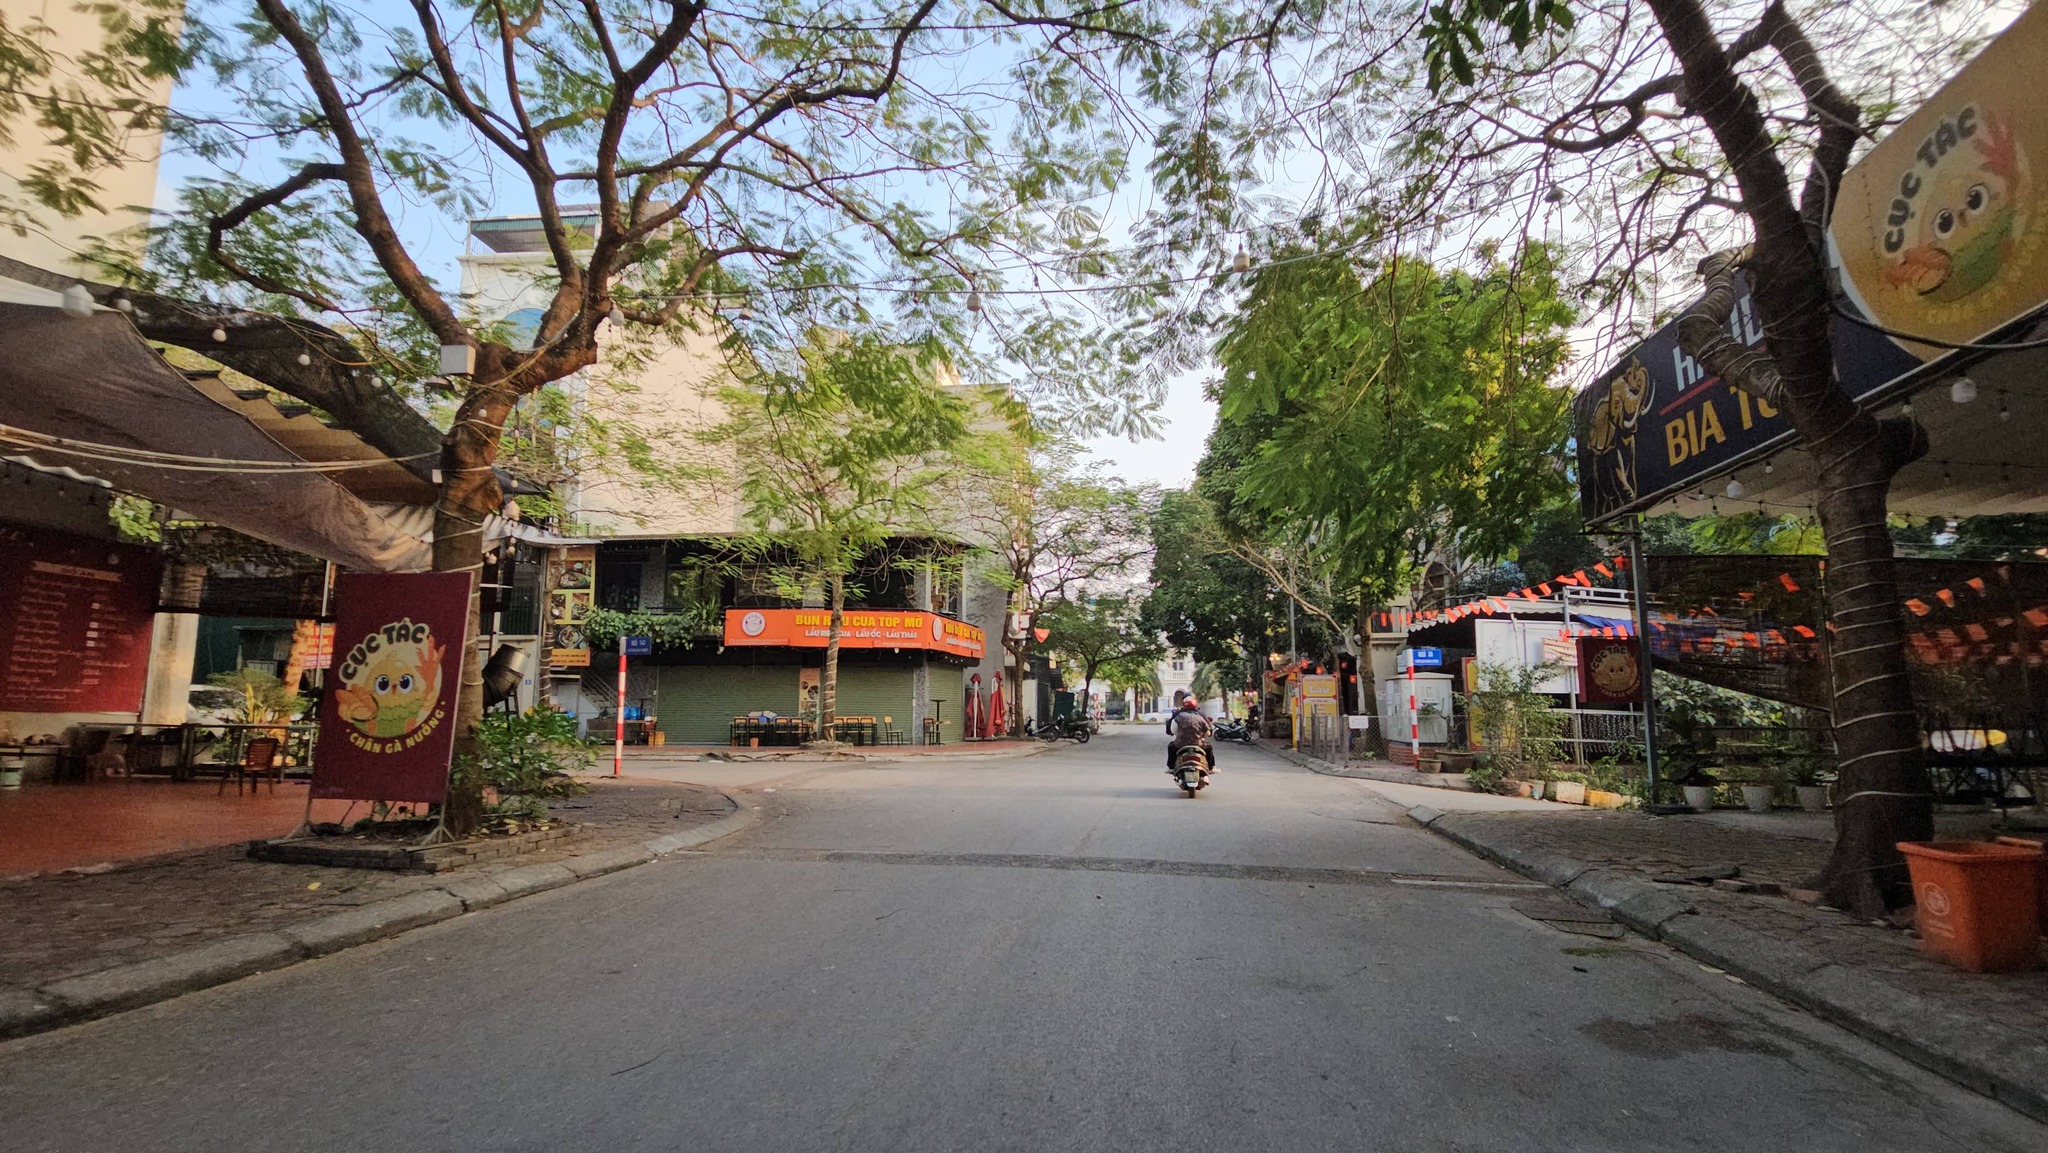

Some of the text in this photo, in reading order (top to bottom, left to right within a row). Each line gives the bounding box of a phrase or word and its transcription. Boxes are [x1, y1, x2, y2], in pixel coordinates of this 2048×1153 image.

[1884, 171, 1922, 254] CỤC
[1665, 400, 1727, 467] BIA
[795, 613, 820, 626] BÚN
[852, 616, 876, 628] CUA
[341, 634, 381, 681] CỤC
[382, 618, 427, 645] TÁC
[1592, 650, 1608, 669] CỤC
[349, 732, 382, 753] CHÂN
[385, 739, 403, 754] GÀ
